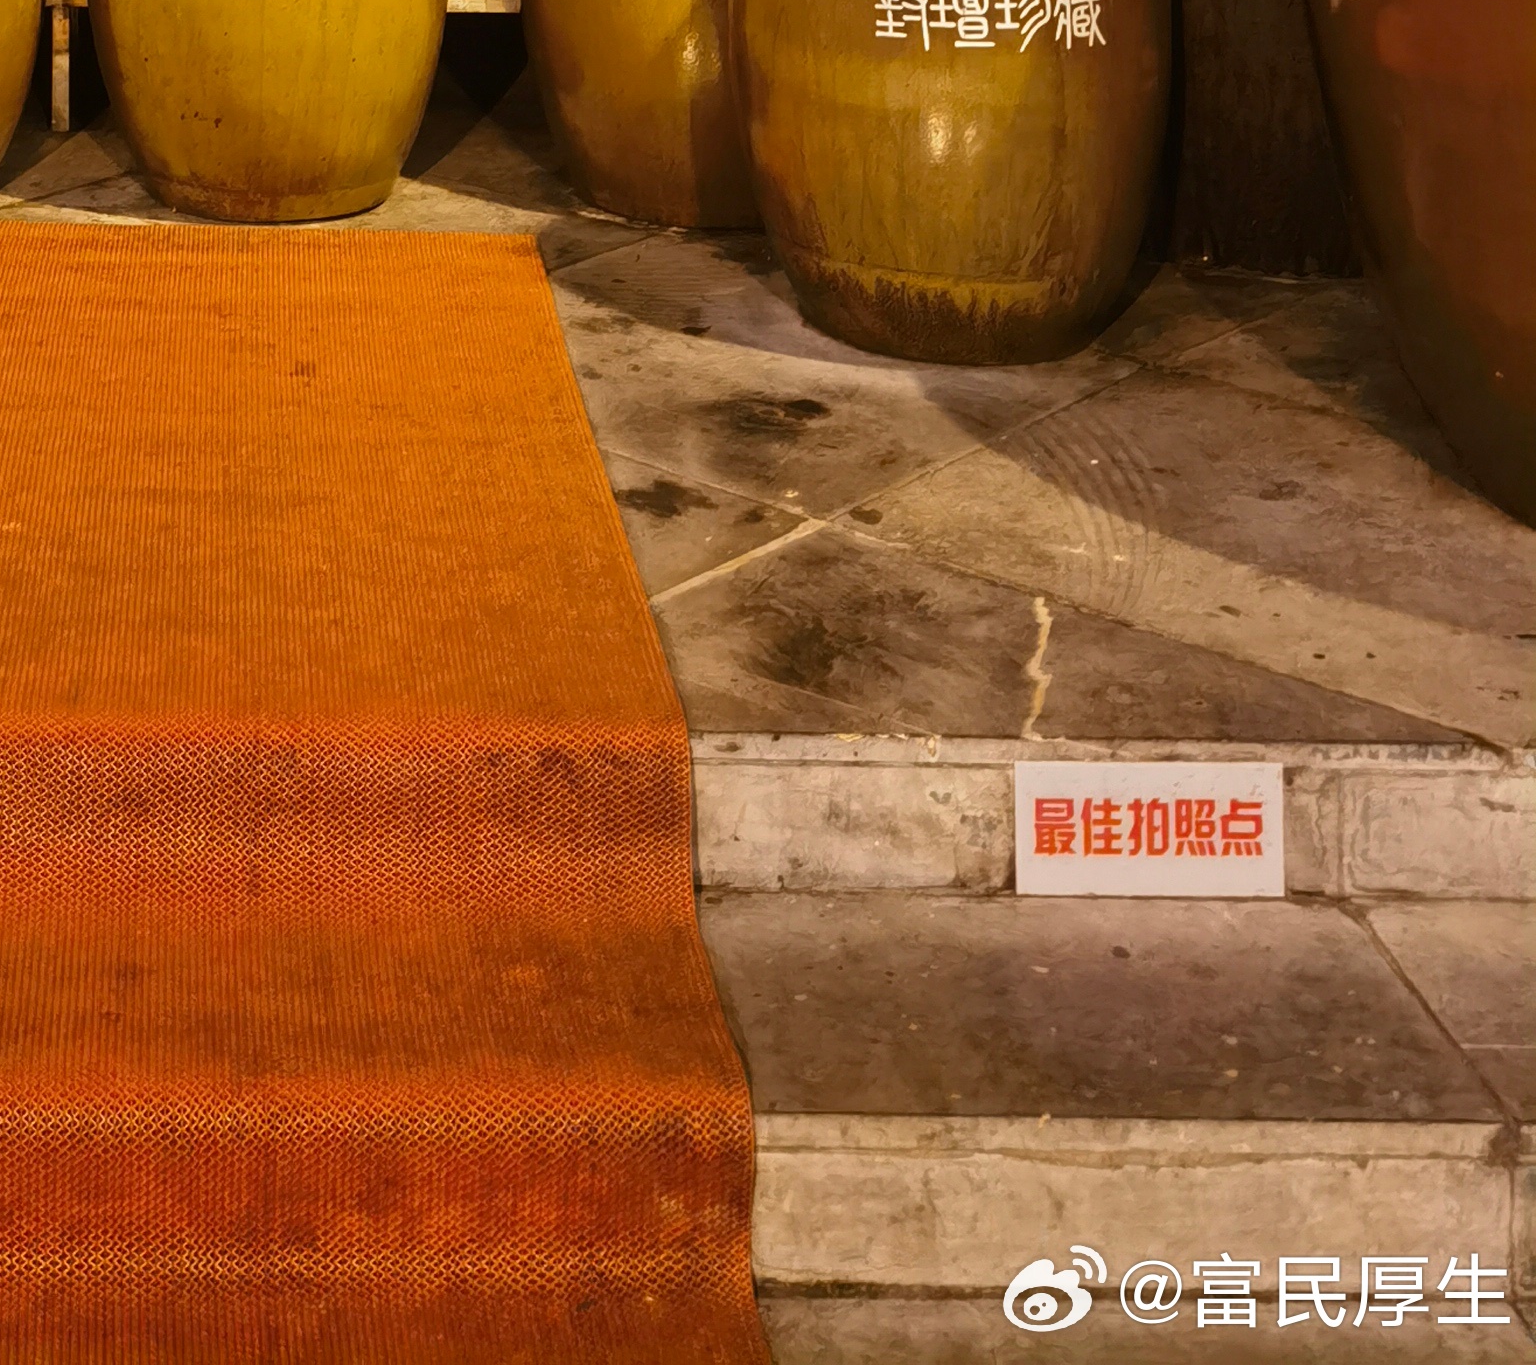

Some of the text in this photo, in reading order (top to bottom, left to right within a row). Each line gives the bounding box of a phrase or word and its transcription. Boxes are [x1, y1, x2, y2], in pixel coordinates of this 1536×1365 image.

[1033, 797, 1264, 857] 最佳拍照点
